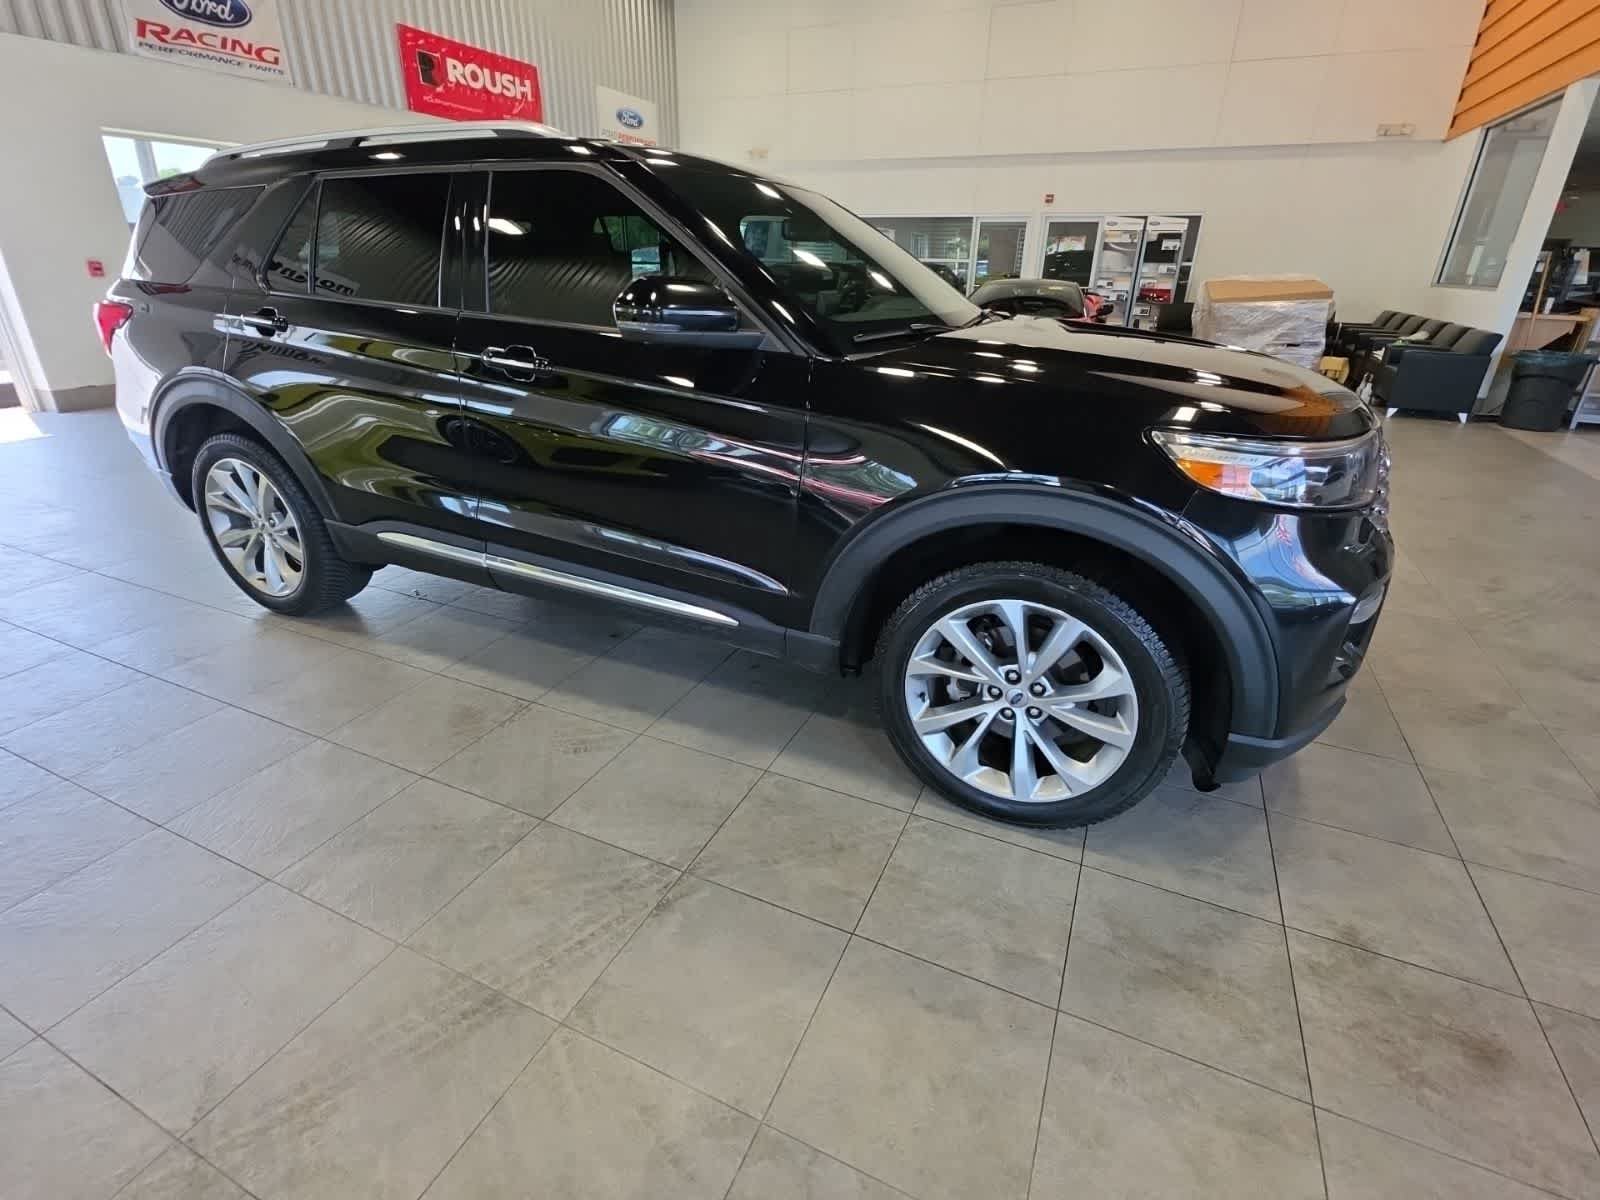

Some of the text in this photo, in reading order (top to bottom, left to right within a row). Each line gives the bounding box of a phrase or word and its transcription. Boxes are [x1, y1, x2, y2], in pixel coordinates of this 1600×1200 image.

[135, 17, 281, 65] RACING
[138, 41, 285, 75] PERFORMANCE PARTS
[445, 56, 533, 102] ROUSH
